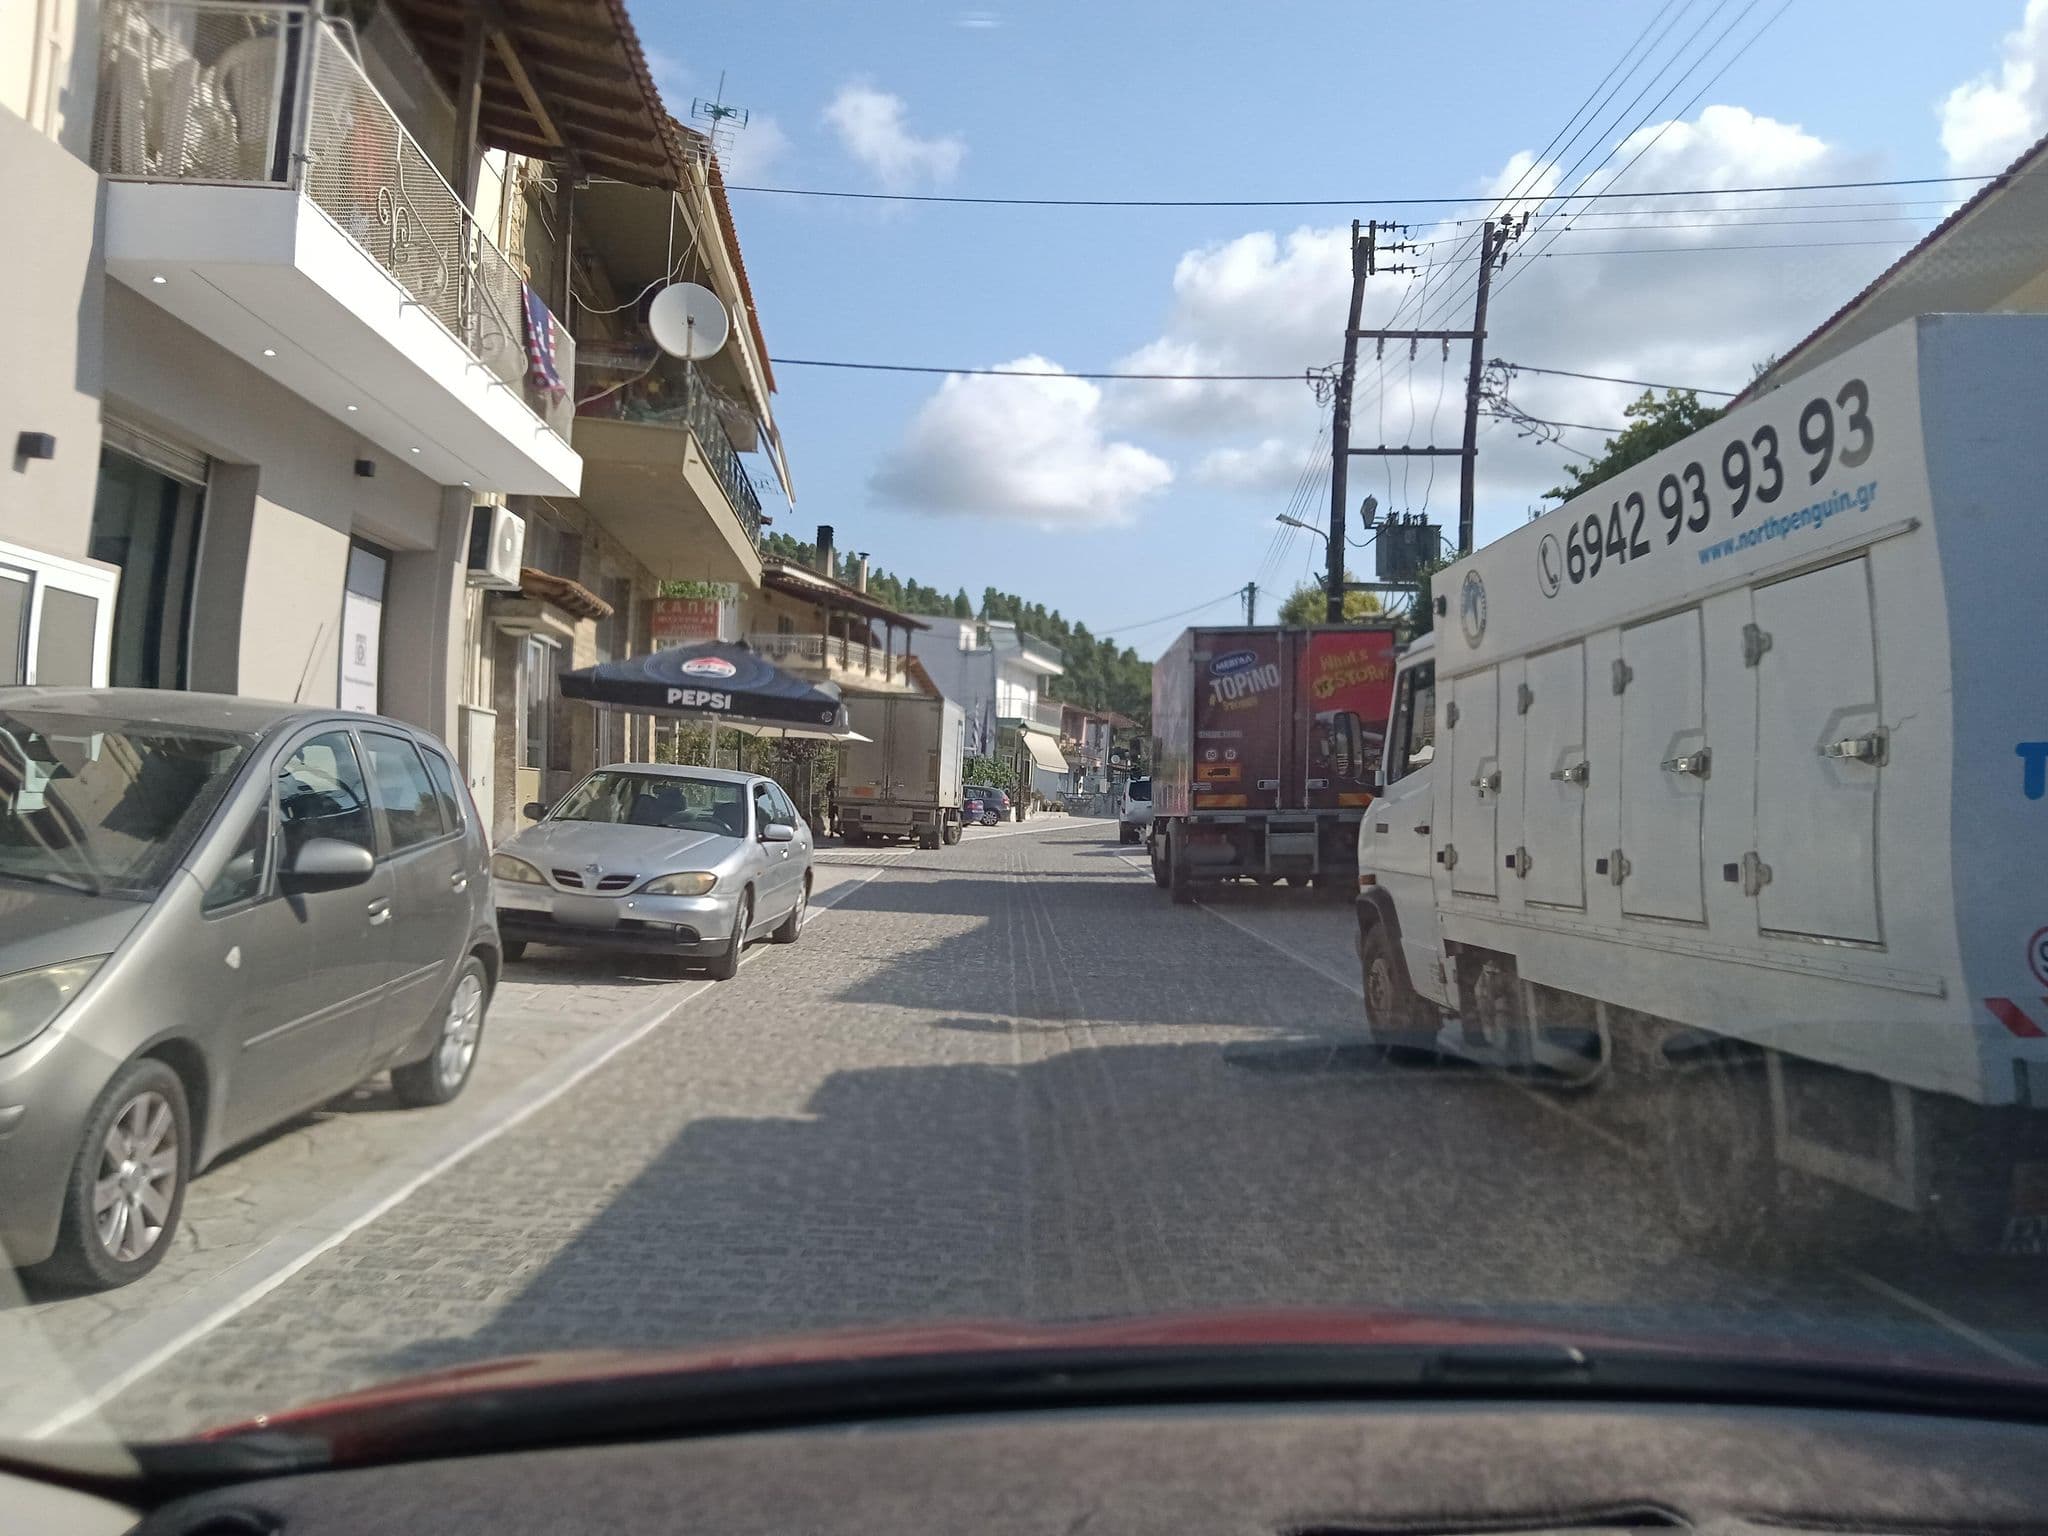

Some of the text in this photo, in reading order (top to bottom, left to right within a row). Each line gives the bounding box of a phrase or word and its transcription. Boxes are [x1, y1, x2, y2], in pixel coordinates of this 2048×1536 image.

[1566, 378, 1875, 584] 6942 93 93 93
[1697, 481, 1878, 565] www.northpenguin.gr
[667, 688, 732, 710] PEPSI
